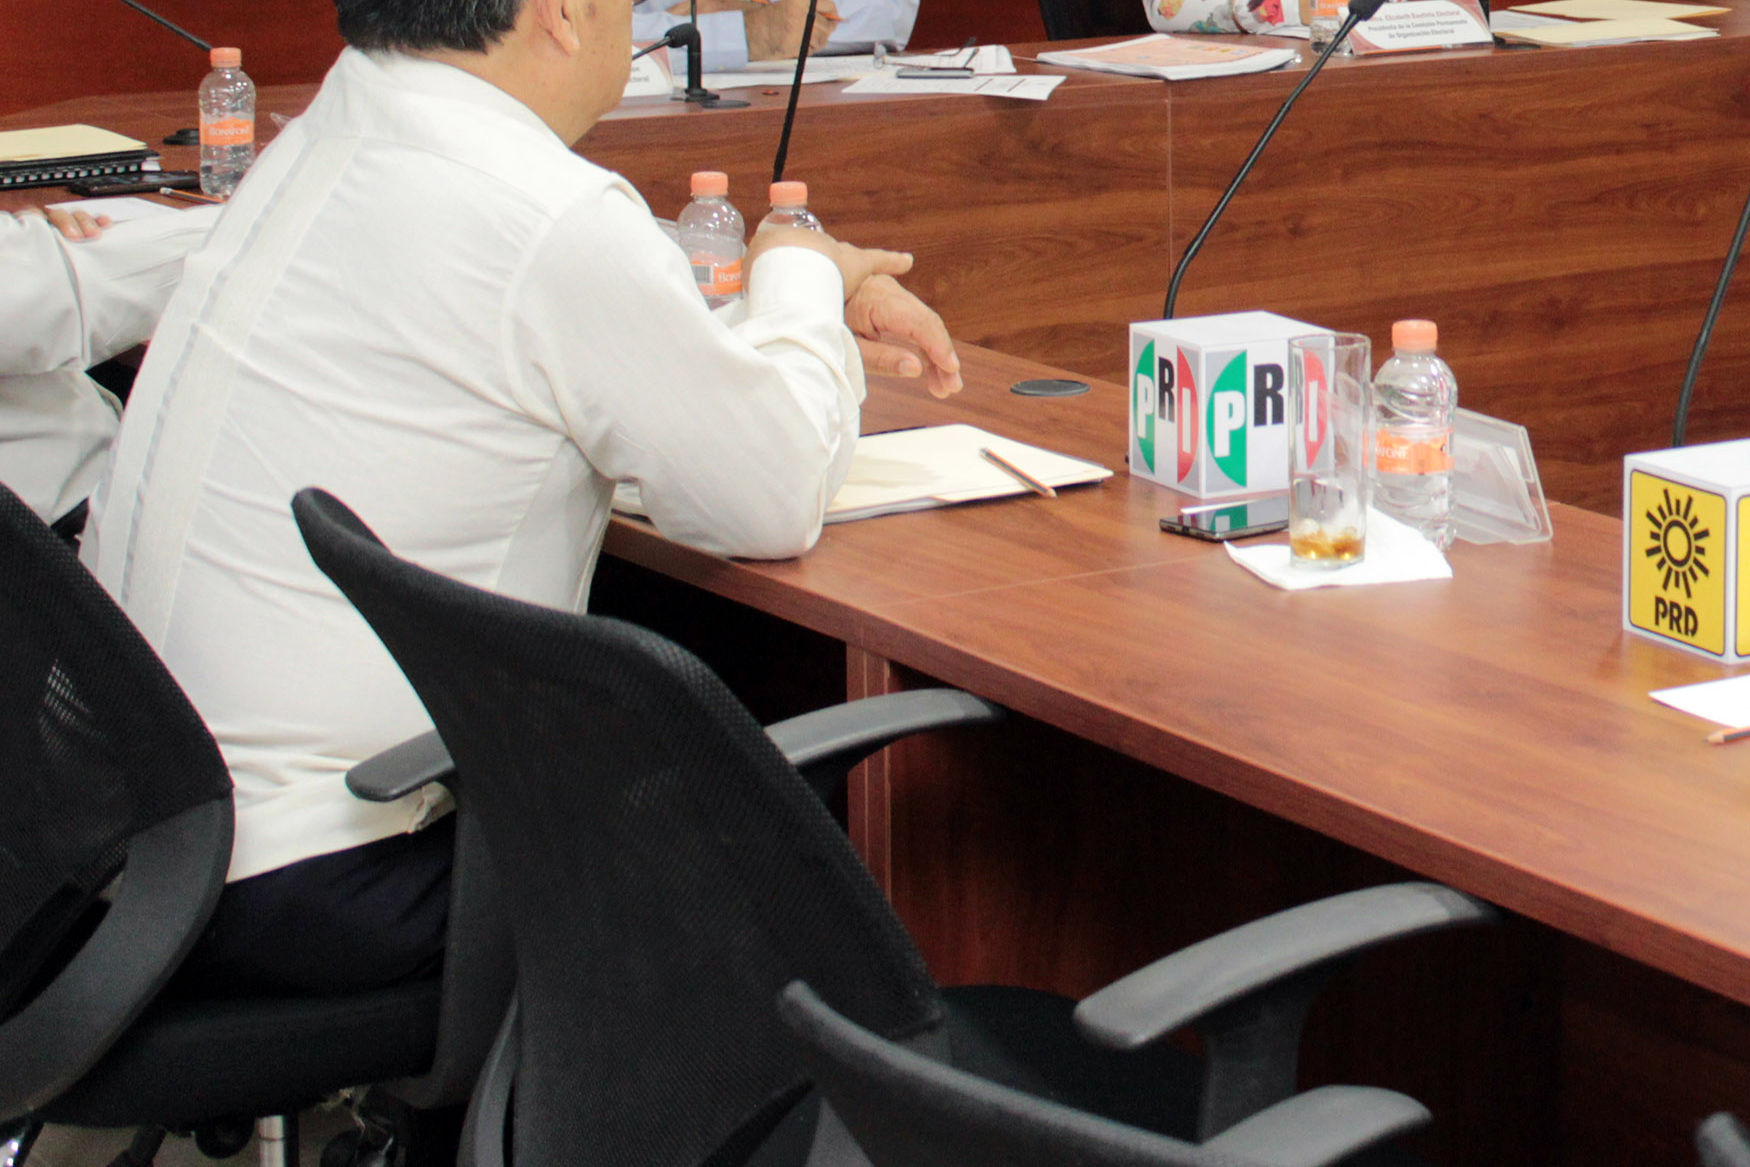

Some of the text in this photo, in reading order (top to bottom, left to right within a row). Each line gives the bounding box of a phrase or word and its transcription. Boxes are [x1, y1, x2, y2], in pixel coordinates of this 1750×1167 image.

[1136, 356, 1193, 454] PRI
[1213, 363, 1318, 454] PRI
[1655, 596, 1698, 637] PRD
